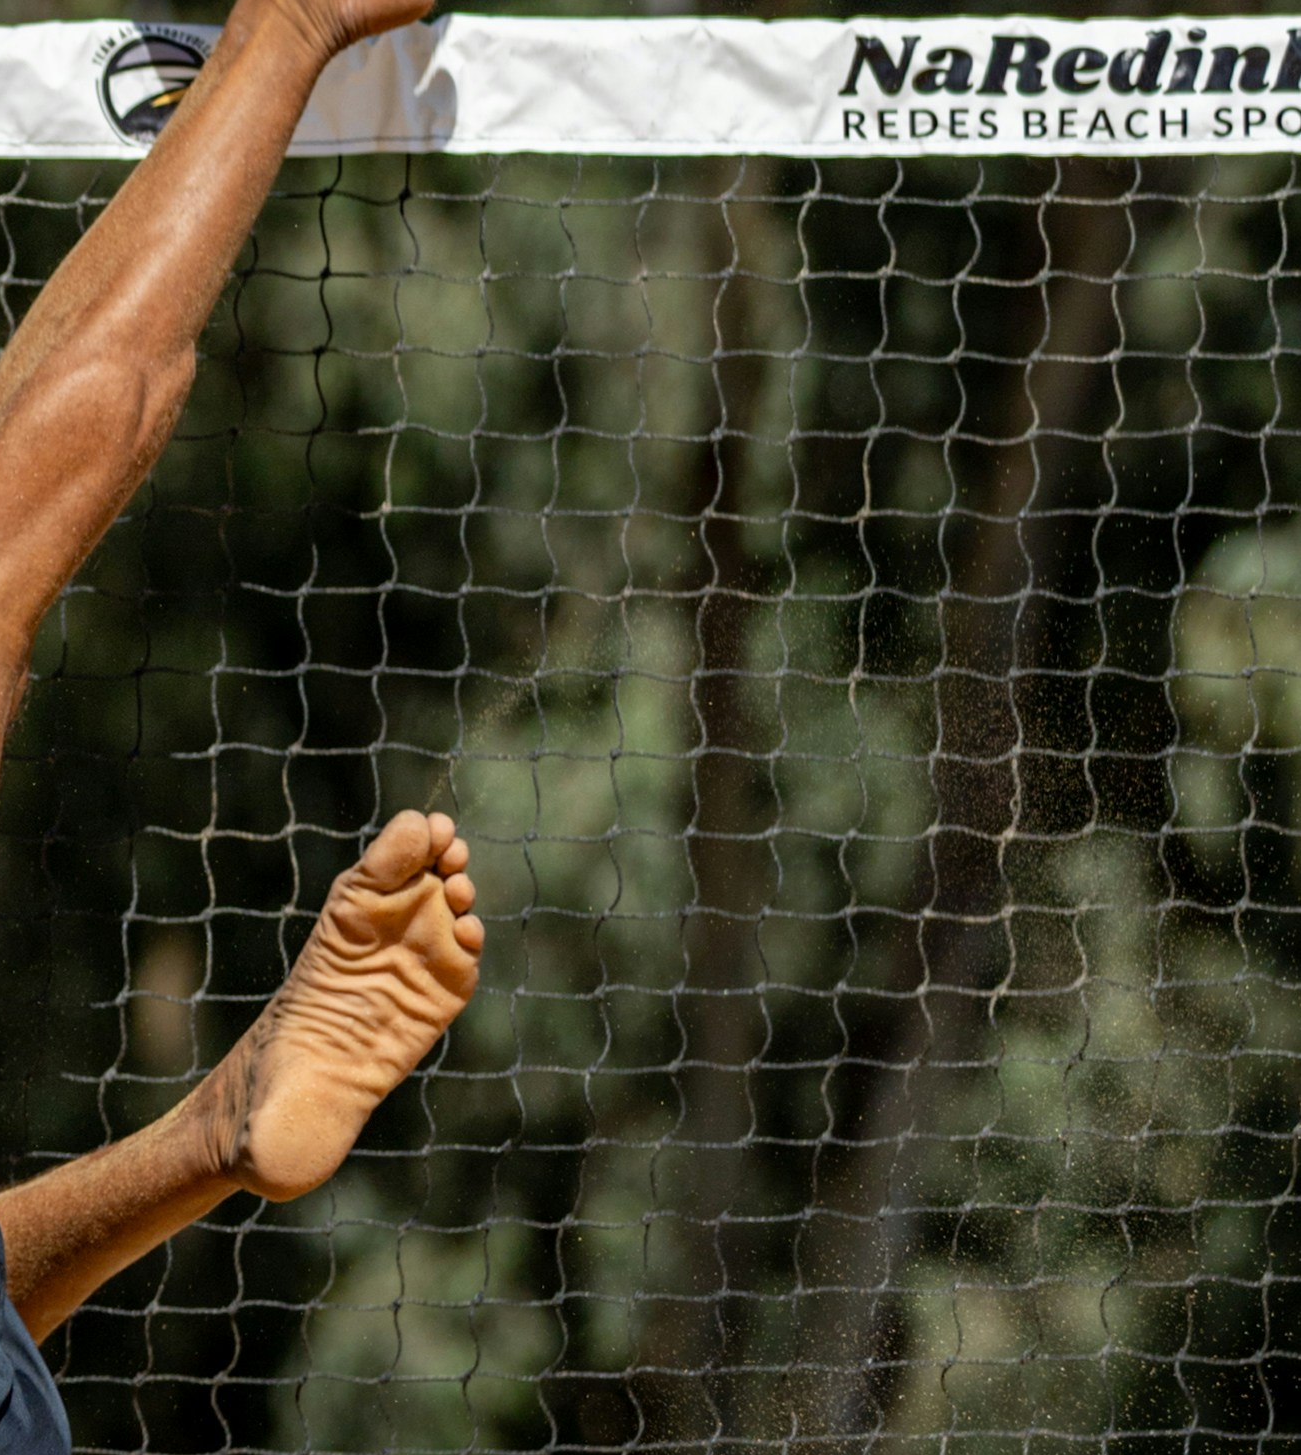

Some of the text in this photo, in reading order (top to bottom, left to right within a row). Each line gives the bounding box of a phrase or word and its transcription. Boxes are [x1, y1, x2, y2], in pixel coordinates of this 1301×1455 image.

[843, 106, 1301, 139] REDES BEACH SPO
